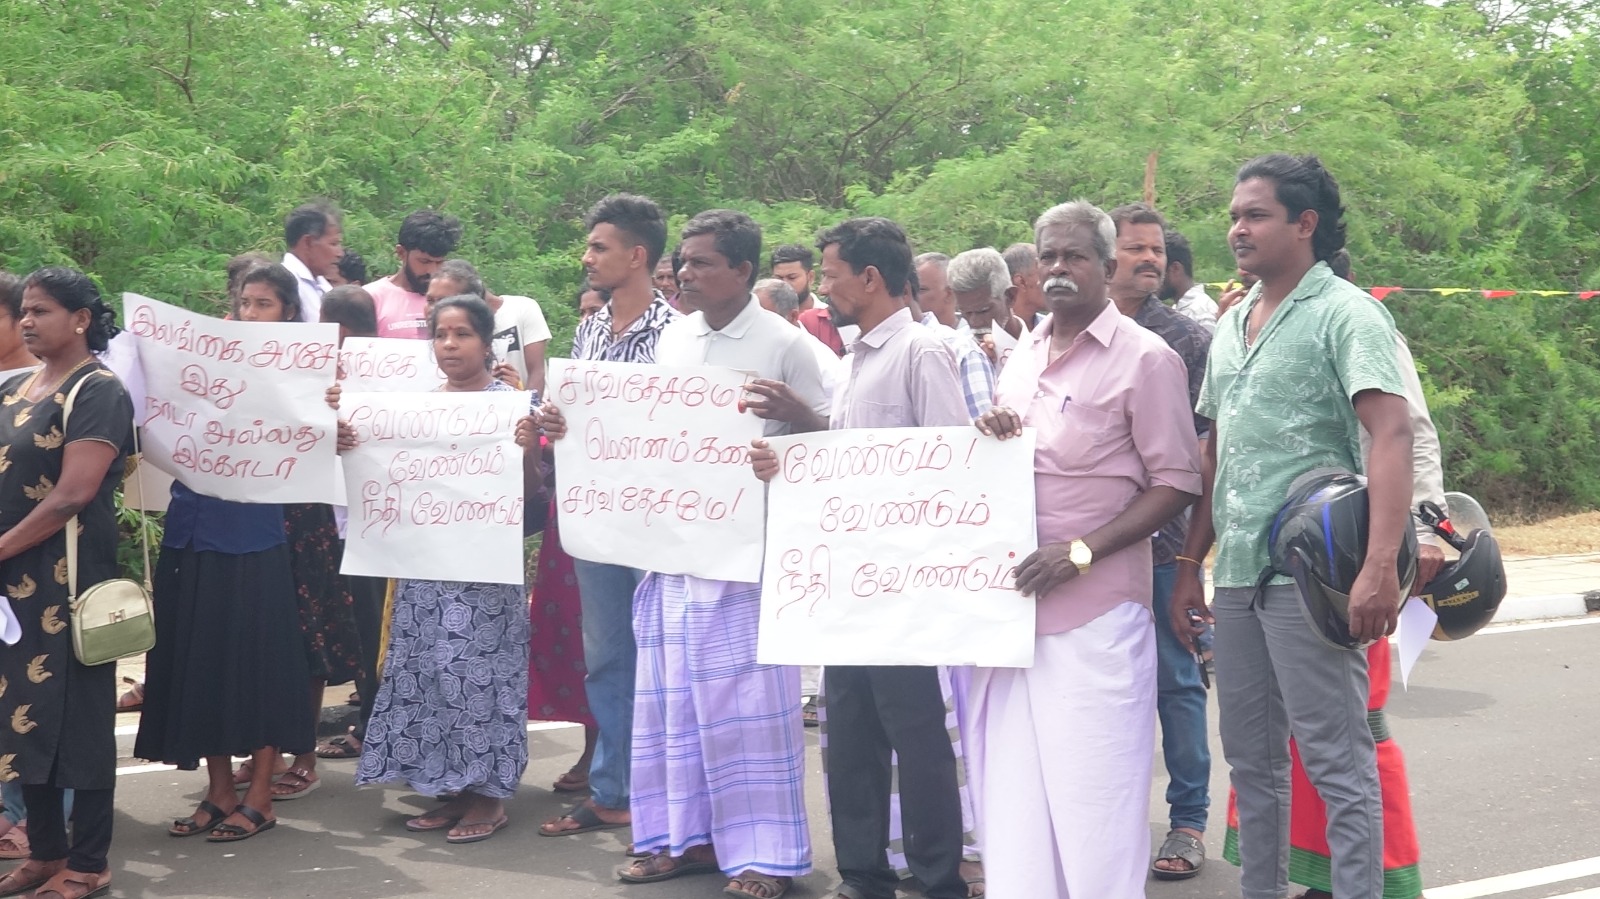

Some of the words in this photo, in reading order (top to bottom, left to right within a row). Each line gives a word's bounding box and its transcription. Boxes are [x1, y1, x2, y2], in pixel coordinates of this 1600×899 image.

[131, 304, 245, 363] இலங்கை
[249, 340, 336, 370] அரசே
[180, 364, 247, 410] இது
[143, 396, 197, 430] நாடா
[203, 419, 325, 452] அல்லது
[388, 444, 505, 482] வேண்டும்
[361, 480, 402, 539] நீதி
[411, 491, 524, 525] வேண்டும்
[819, 489, 991, 532] வேண்டும்
[776, 544, 831, 619] நீதி
